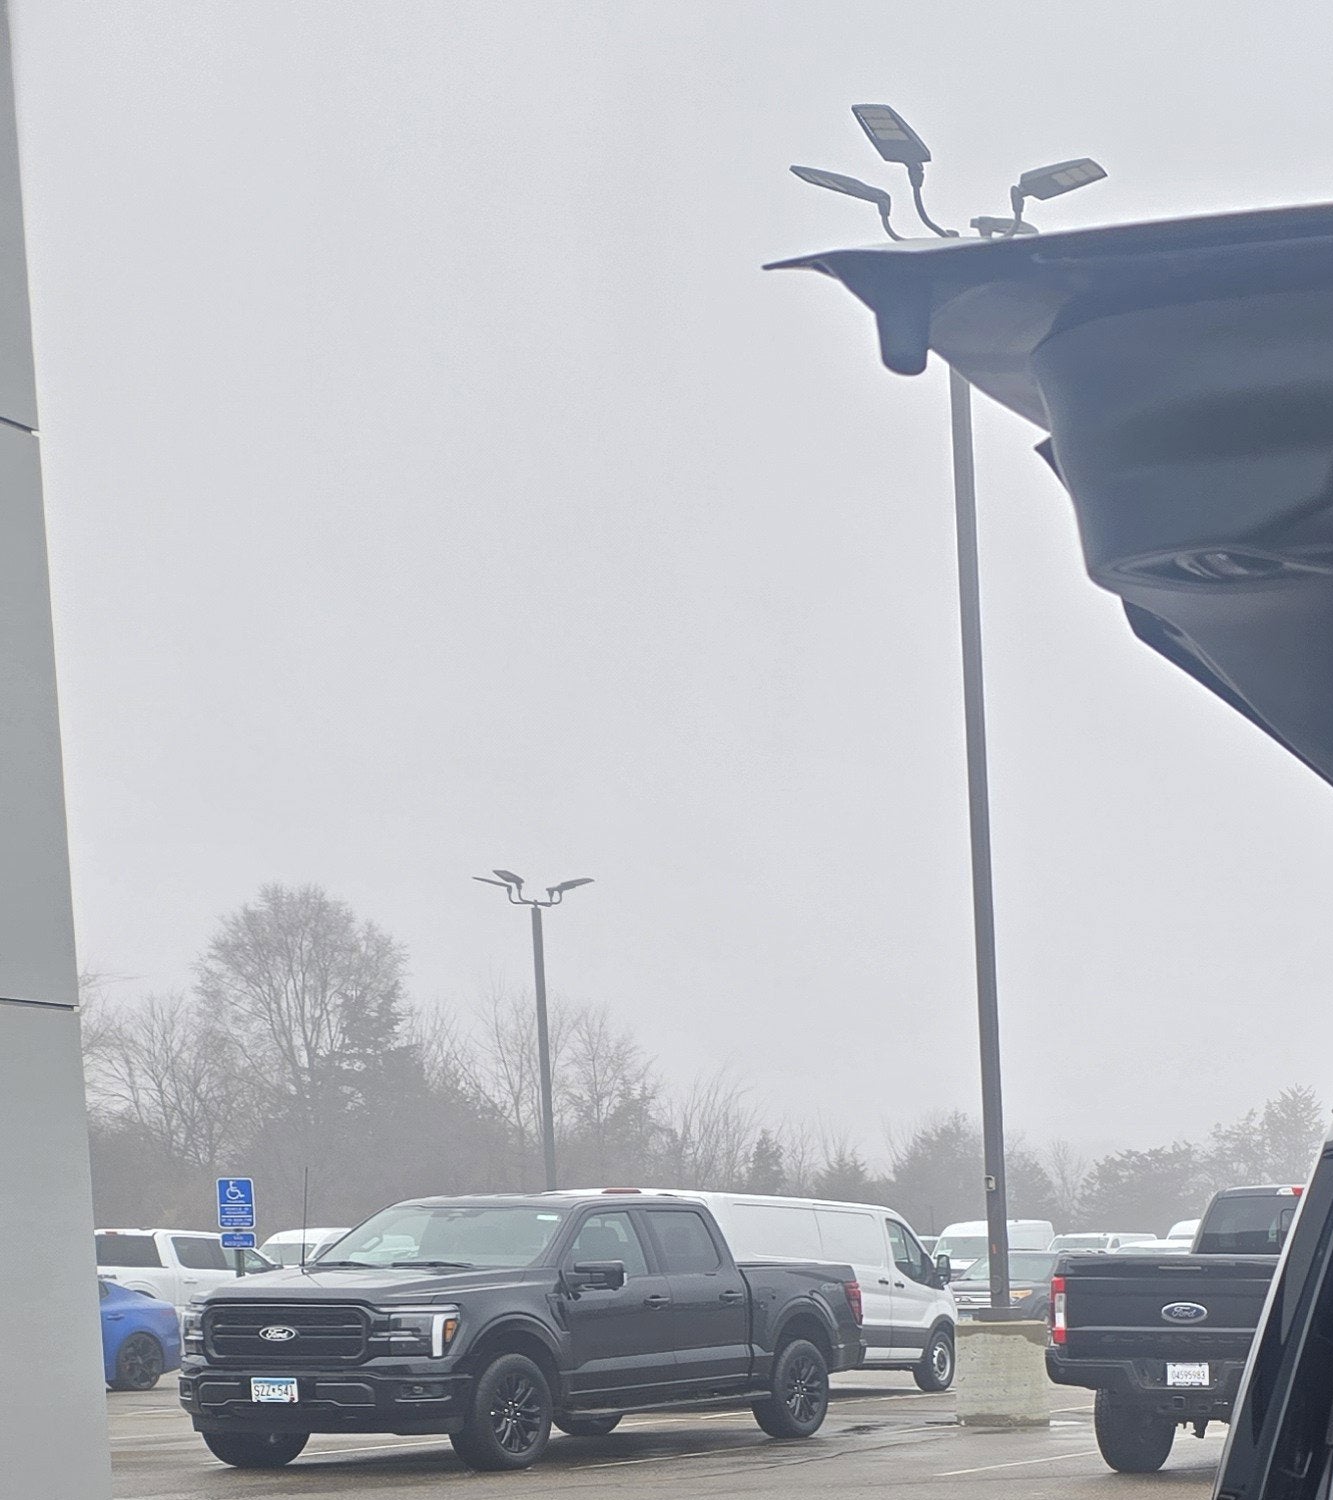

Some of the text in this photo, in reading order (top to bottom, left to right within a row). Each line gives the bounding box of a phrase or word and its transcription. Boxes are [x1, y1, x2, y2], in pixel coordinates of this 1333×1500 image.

[1171, 1307, 1197, 1318] Ford
[254, 1385, 295, 1397] SZZ 541
